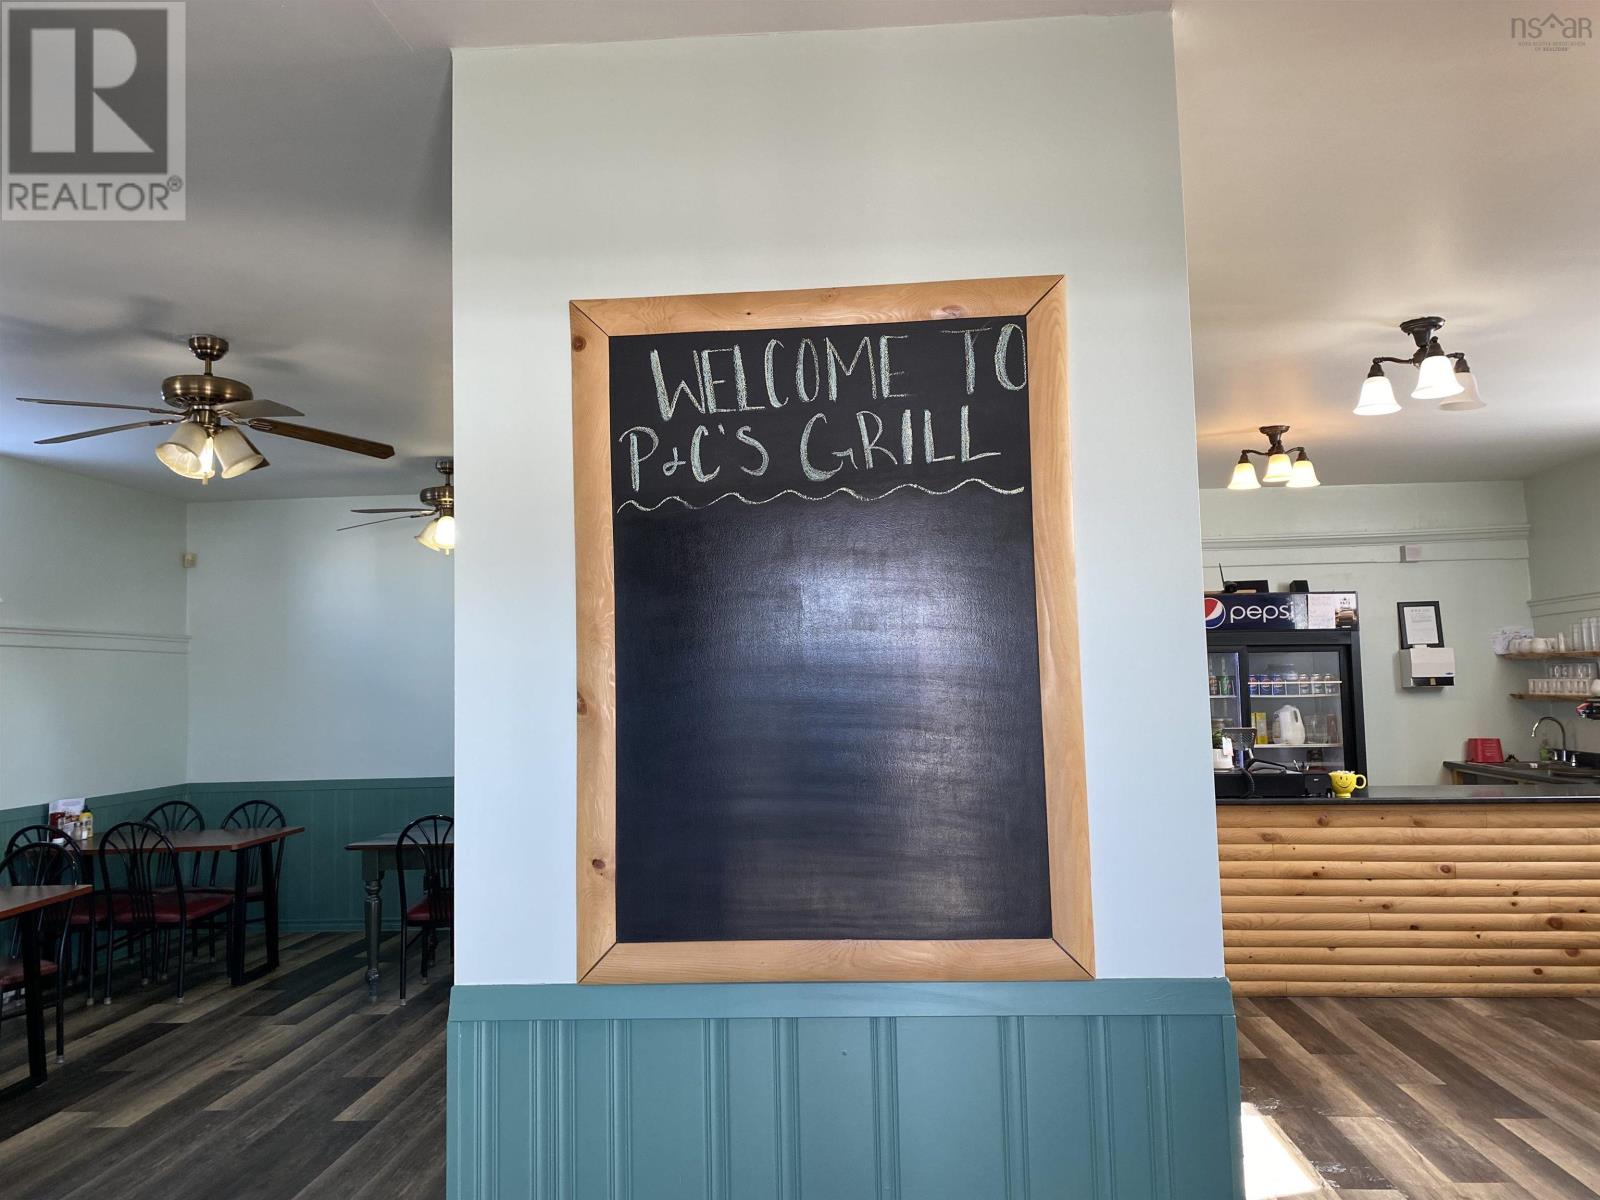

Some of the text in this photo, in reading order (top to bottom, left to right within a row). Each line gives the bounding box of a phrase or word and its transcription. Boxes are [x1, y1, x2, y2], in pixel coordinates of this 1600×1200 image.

[649, 322, 1028, 422] WELCOME TO
[799, 404, 1002, 482] GRILL
